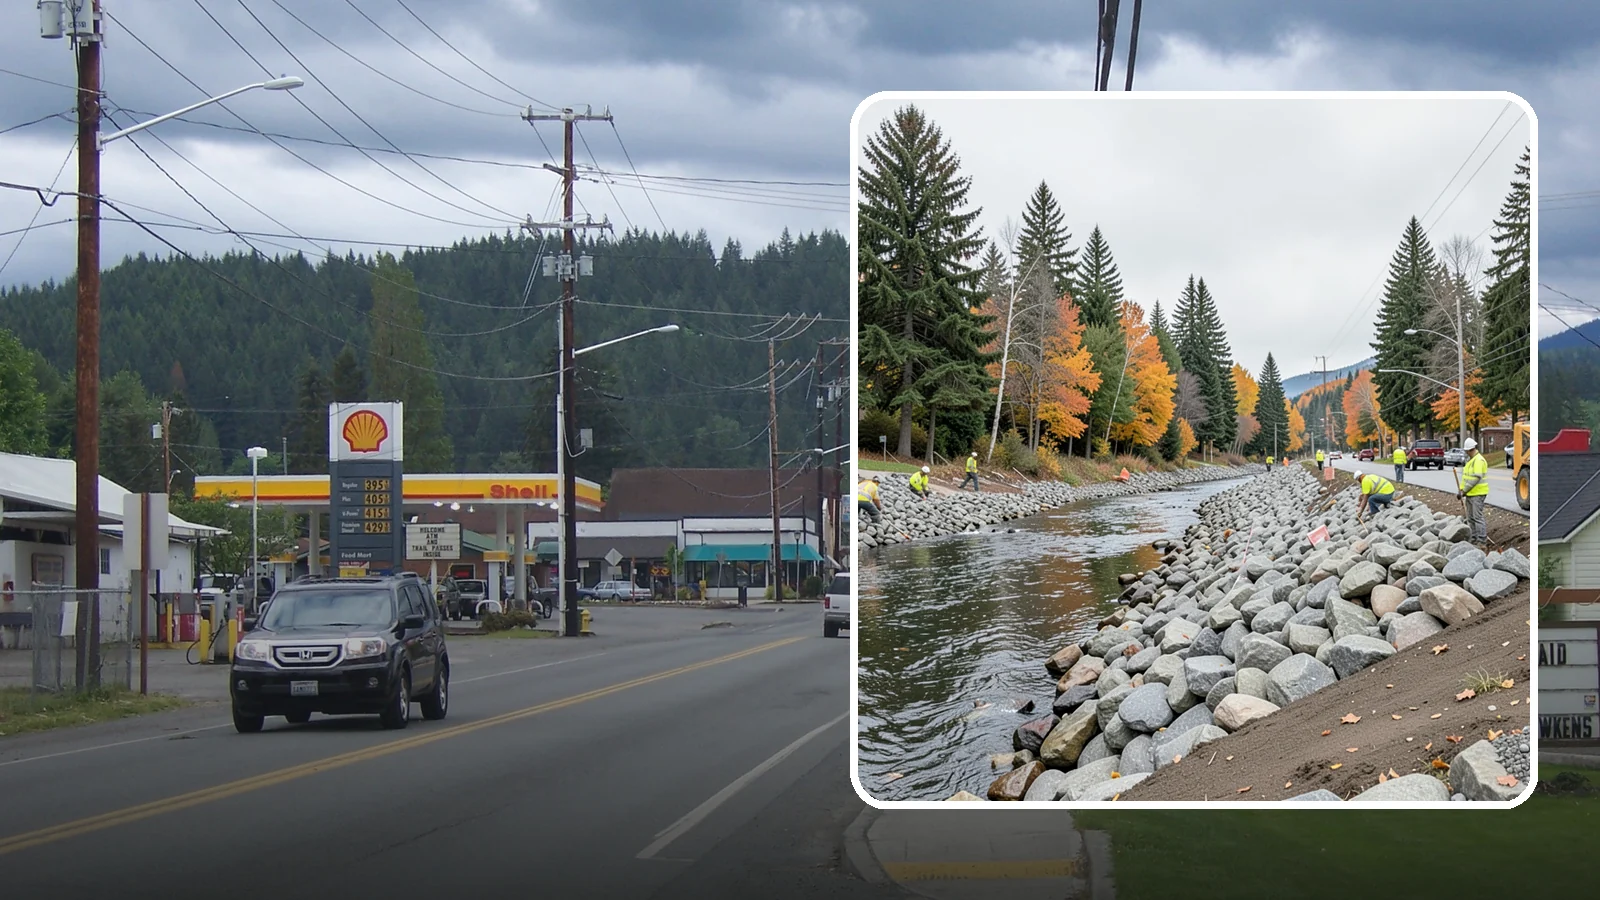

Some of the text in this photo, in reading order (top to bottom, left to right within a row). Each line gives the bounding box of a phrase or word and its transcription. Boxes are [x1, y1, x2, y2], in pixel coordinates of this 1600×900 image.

[366, 480, 383, 490] 395
[490, 484, 547, 499] Shell
[365, 494, 383, 504] 405
[365, 508, 383, 518] 415
[366, 522, 384, 533] 429
